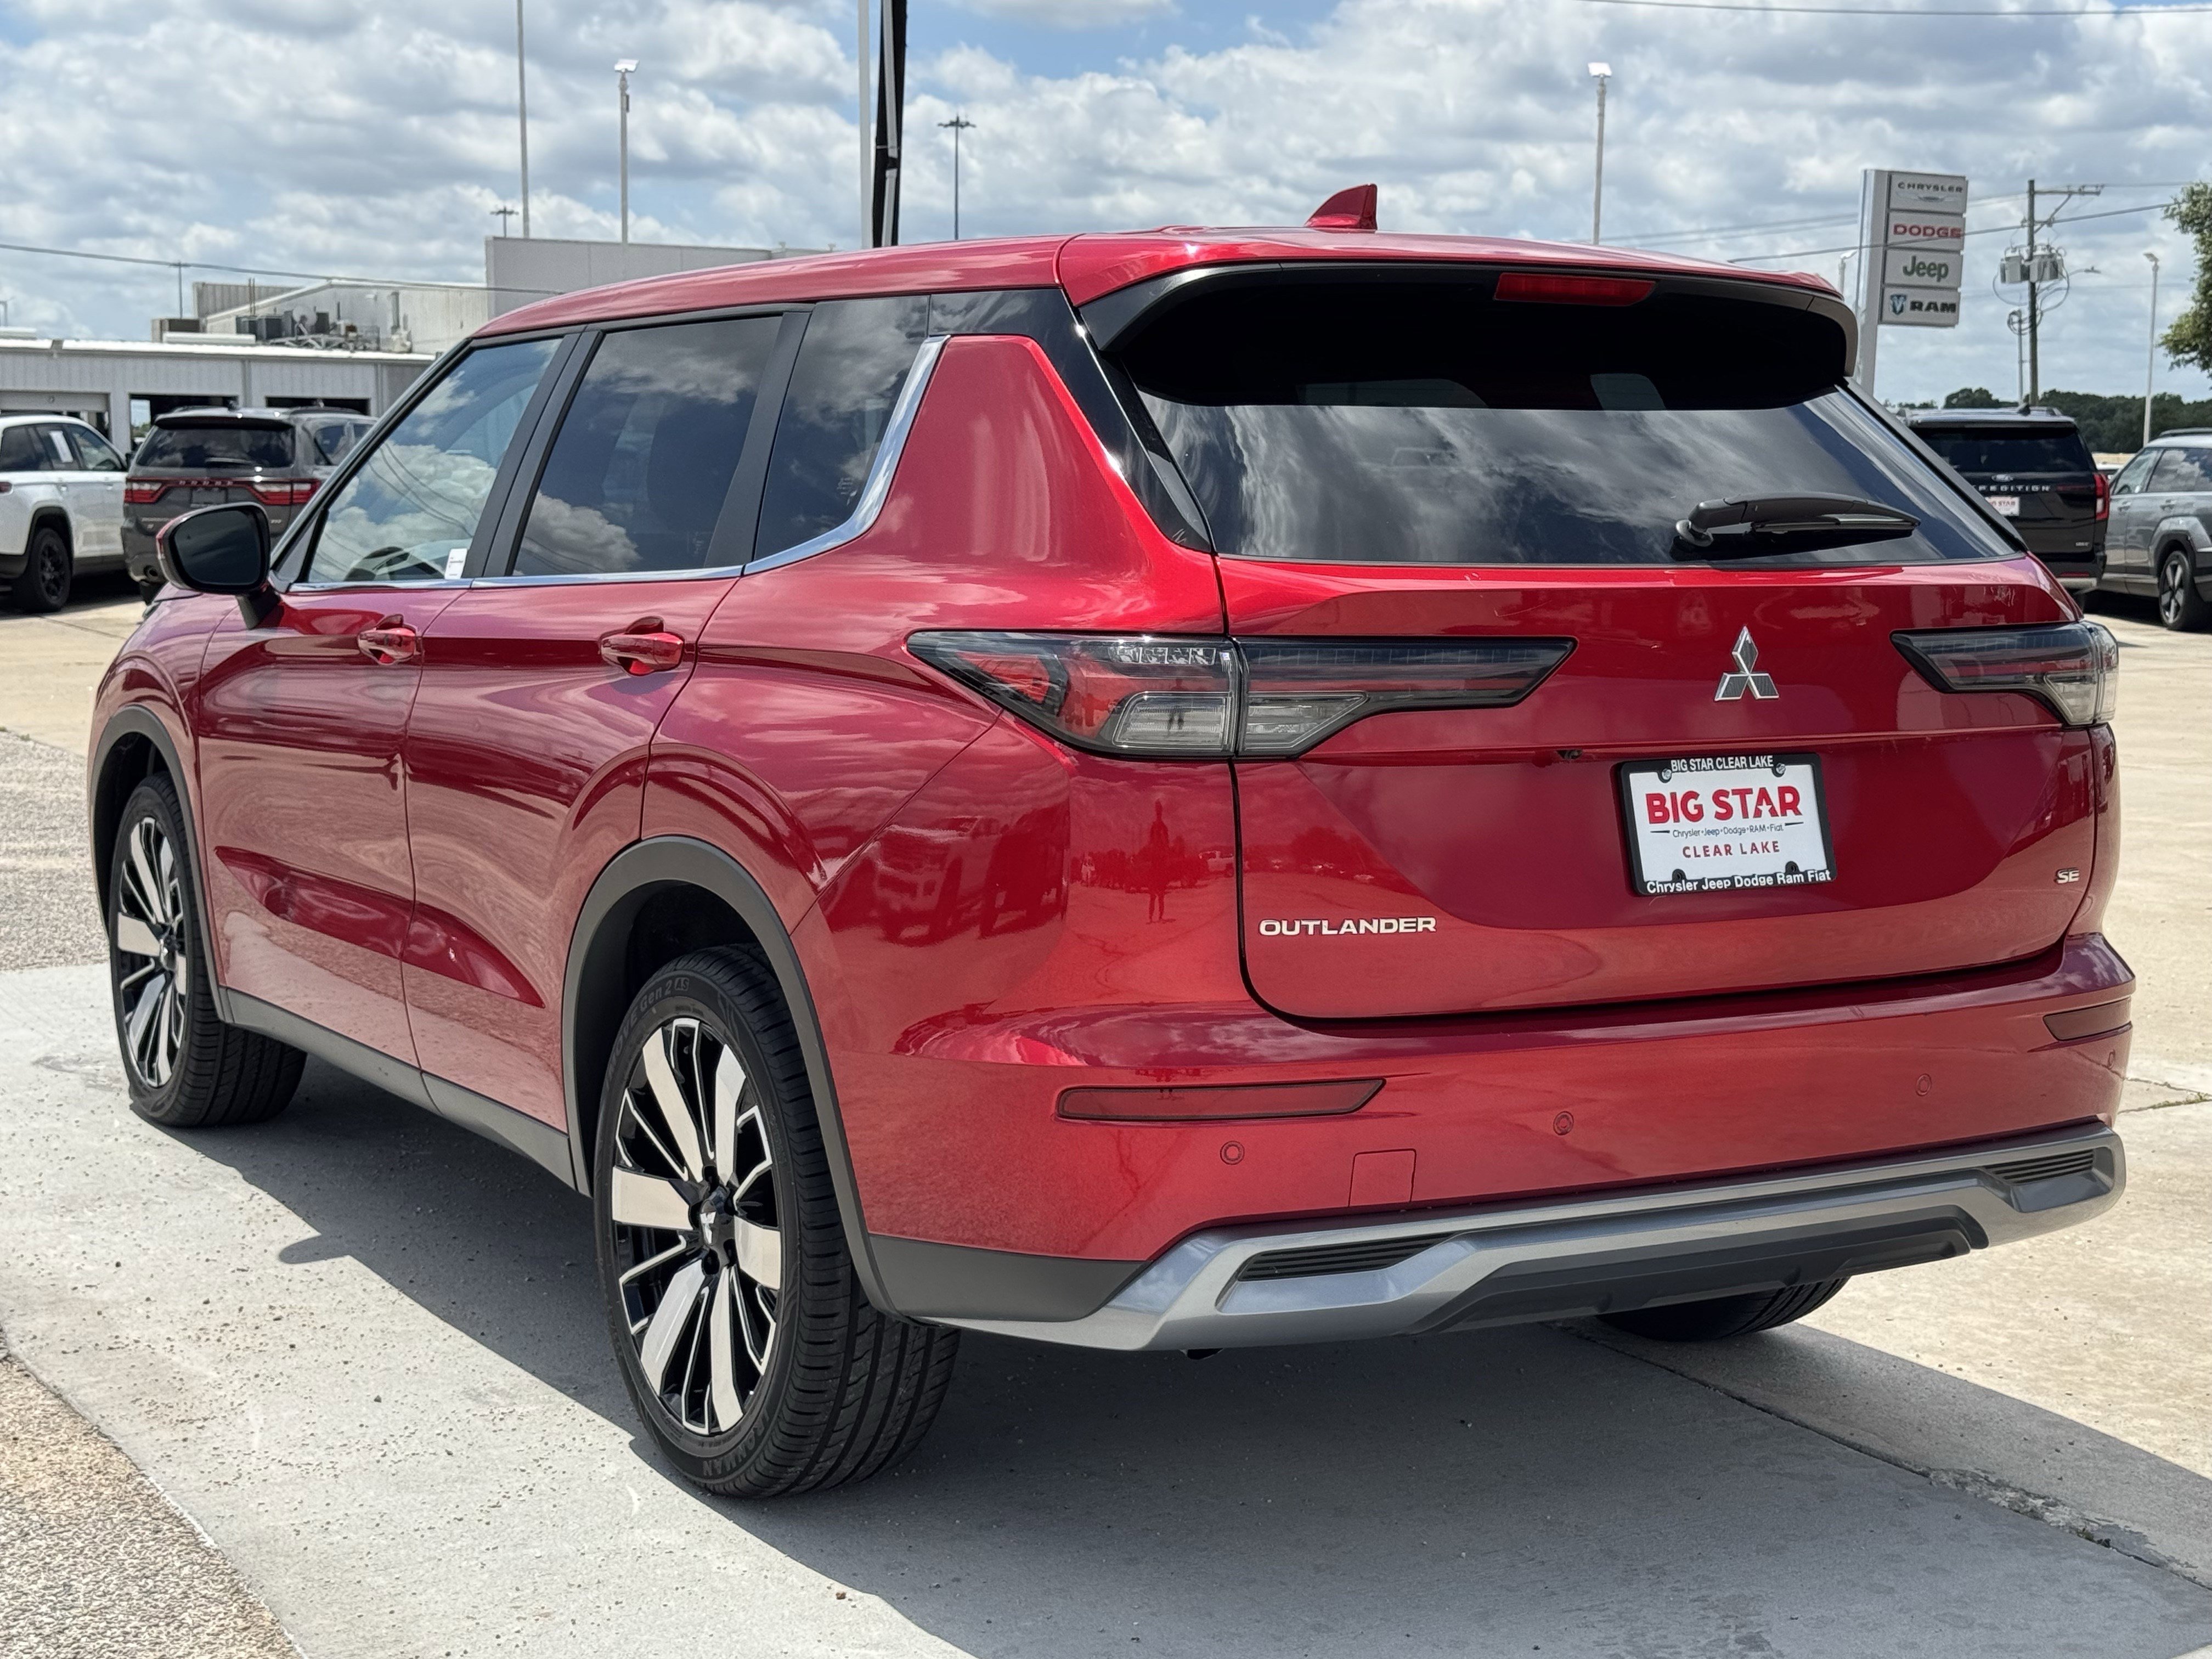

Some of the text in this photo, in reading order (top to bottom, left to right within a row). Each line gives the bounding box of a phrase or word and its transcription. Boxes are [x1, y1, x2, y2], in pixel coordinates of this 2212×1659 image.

[1898, 181, 1962, 193] CHRYSLER
[1893, 223, 1962, 239] DODGE
[1902, 256, 1949, 282] Jeep
[1909, 300, 1956, 313] RAM
[1671, 755, 1774, 772] BIG STAR CLEAR LAKE
[1645, 786, 1803, 824] BIG STAR
[1682, 840, 1780, 859] CLEAR LAKE
[1646, 869, 1831, 893] Chrysler Jeep Dodge Ram Fiat
[2057, 869, 2080, 884] SE
[1259, 917, 1437, 936] OUTLANDER
